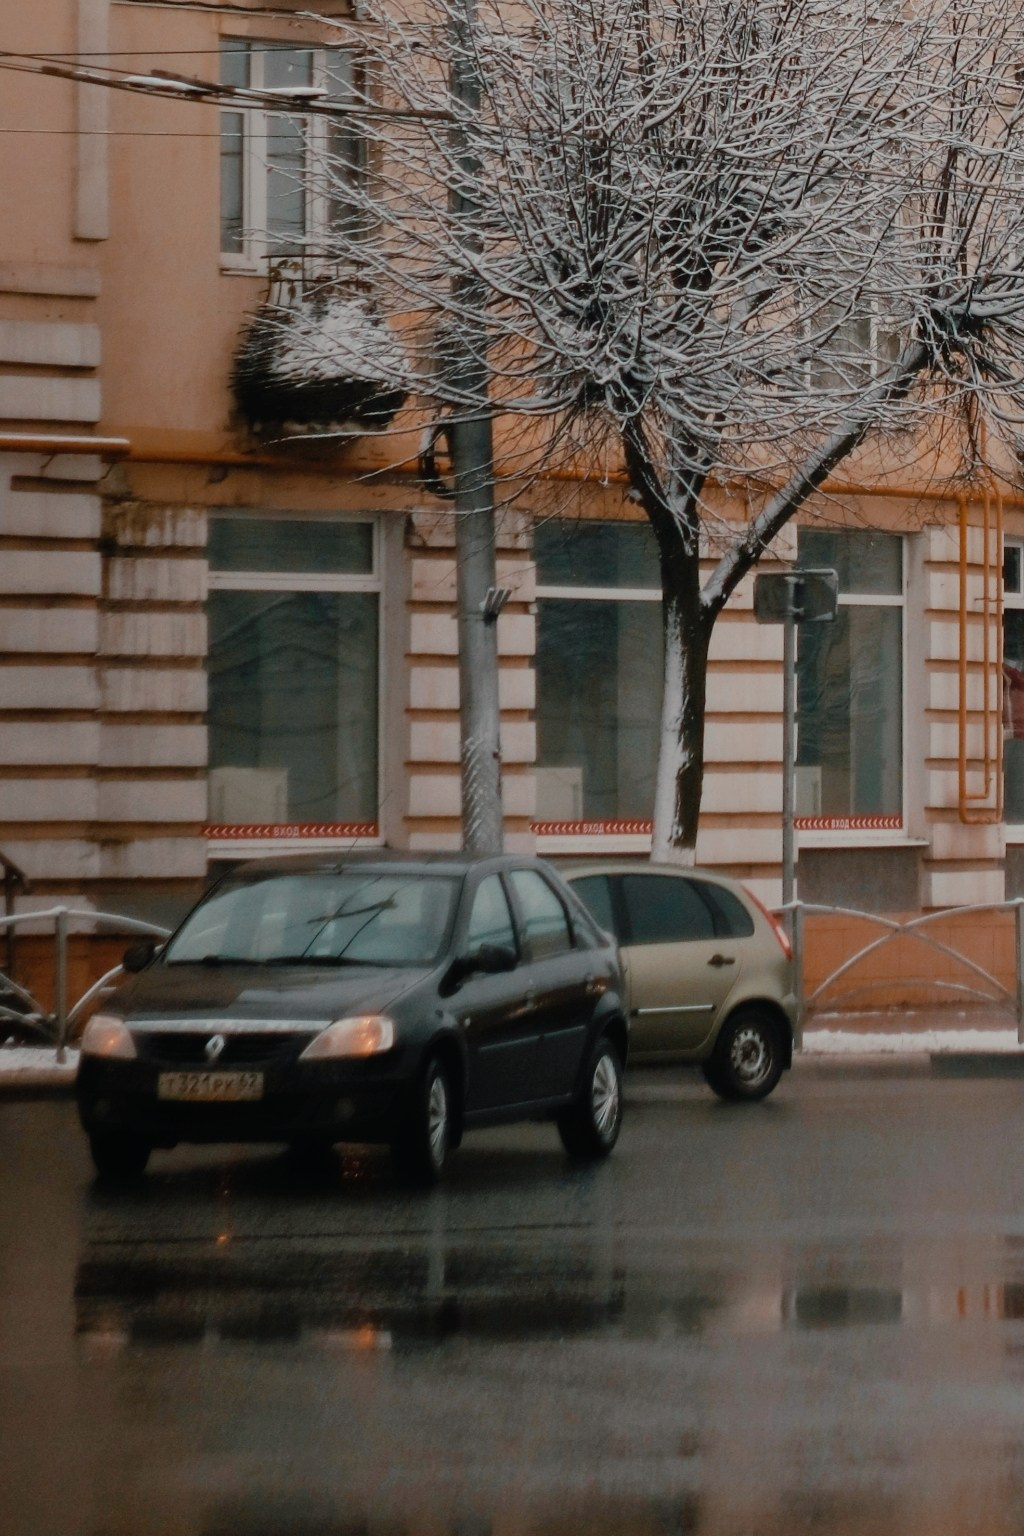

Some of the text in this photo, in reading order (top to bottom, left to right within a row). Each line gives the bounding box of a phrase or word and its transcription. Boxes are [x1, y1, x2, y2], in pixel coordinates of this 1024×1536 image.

[582, 823, 605, 834] ВХОД
[831, 818, 850, 829] ВХОД
[273, 825, 300, 837] ВХОД
